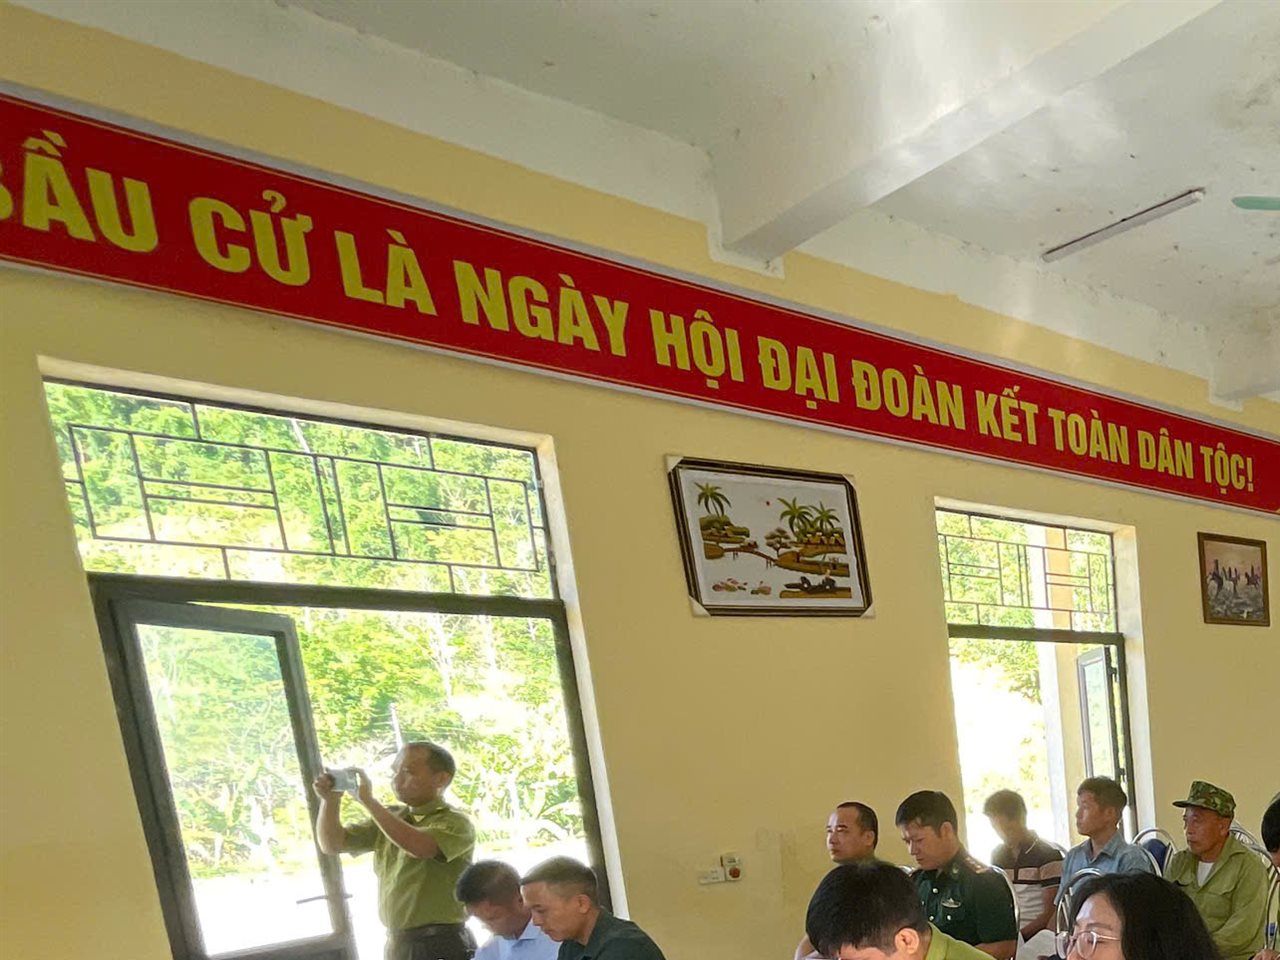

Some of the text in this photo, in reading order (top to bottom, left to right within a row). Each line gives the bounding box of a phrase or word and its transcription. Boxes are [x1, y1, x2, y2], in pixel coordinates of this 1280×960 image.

[0, 129, 1254, 495] ẦU CỬ LÀ NGÀY HỘI ĐẠI ĐOÀN KẾT TOÀN DÂN TỘC!
